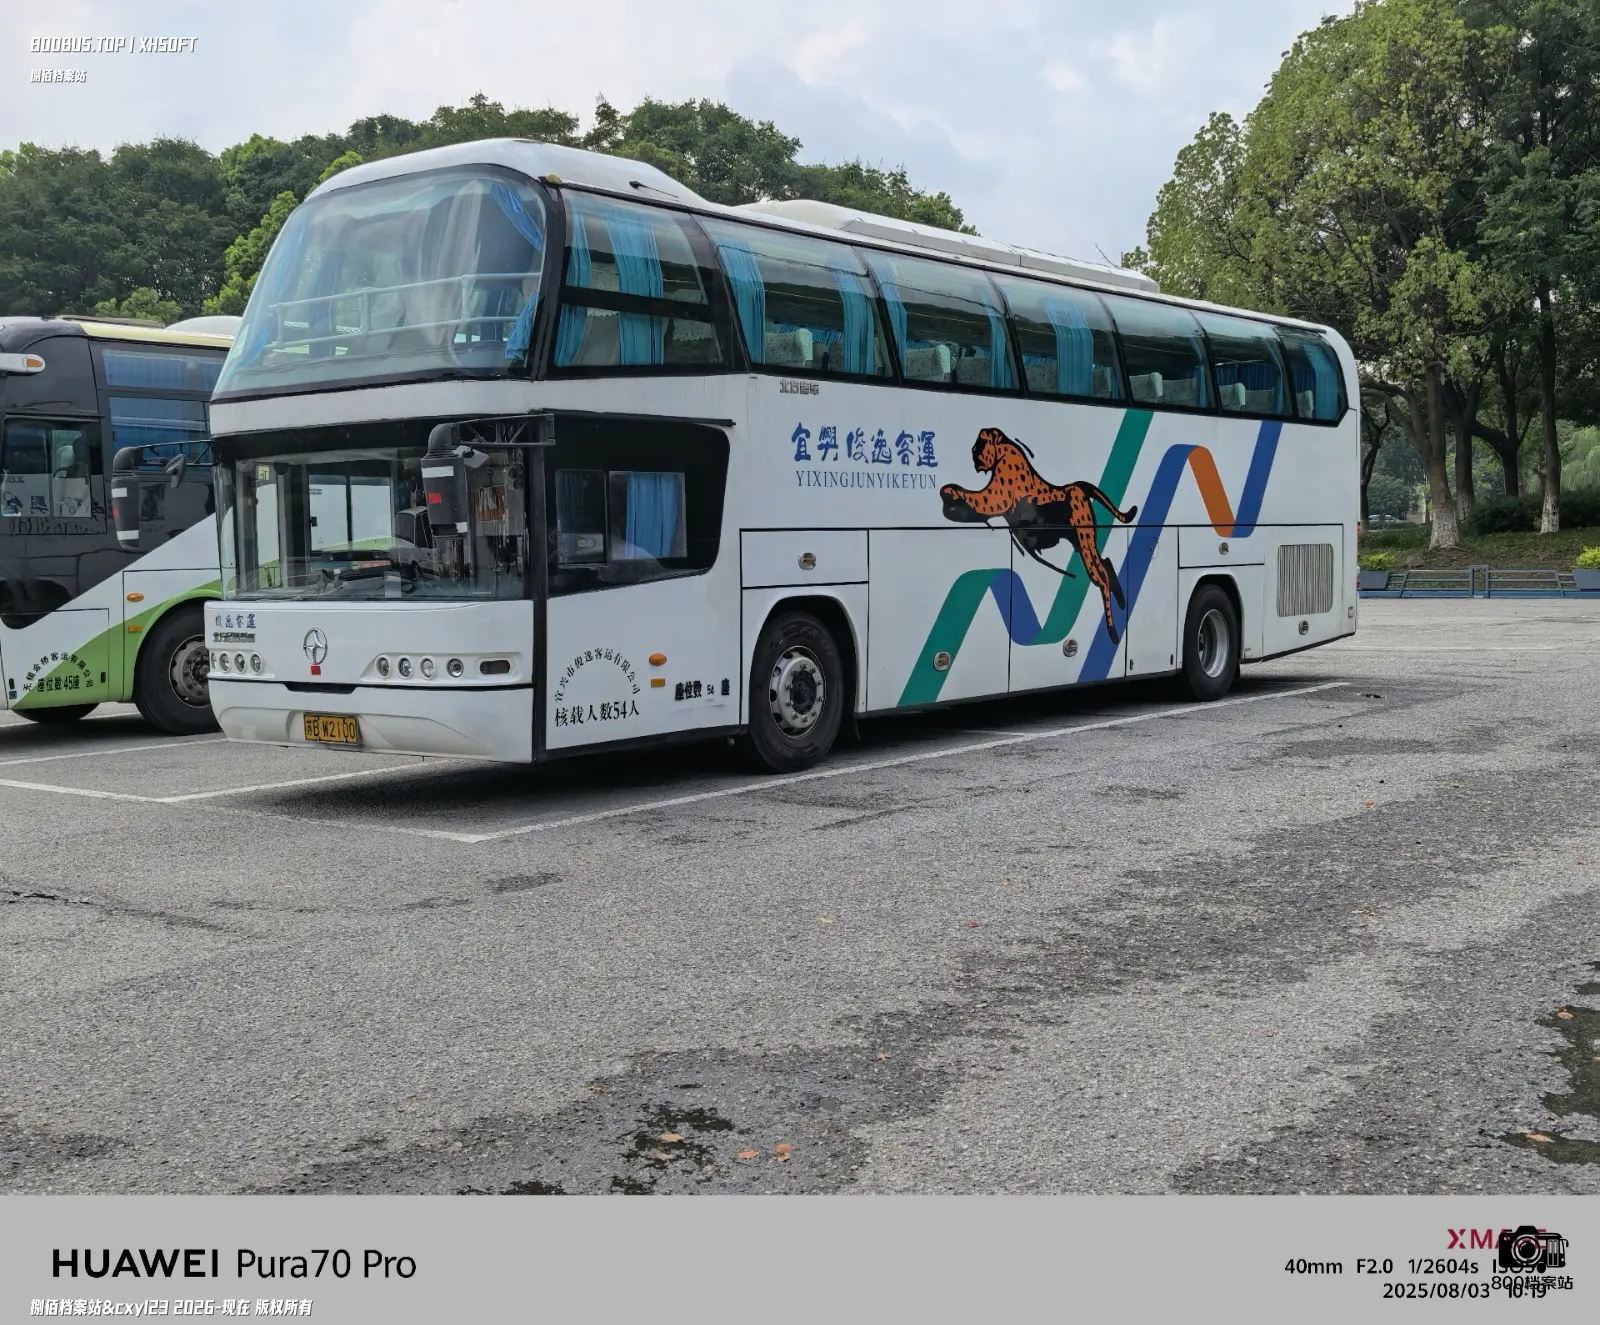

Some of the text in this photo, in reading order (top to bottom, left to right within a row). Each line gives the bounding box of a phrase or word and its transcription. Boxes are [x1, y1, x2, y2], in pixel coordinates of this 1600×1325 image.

[795, 470, 937, 489] YIXINGJUNYIKEYUN
[37, 675, 80, 693] 座位数45座
[554, 647, 641, 703] 宜兴市俊逸客运有限公司
[674, 678, 731, 701] 座位数 54 座
[554, 700, 640, 727] 核载人数54人
